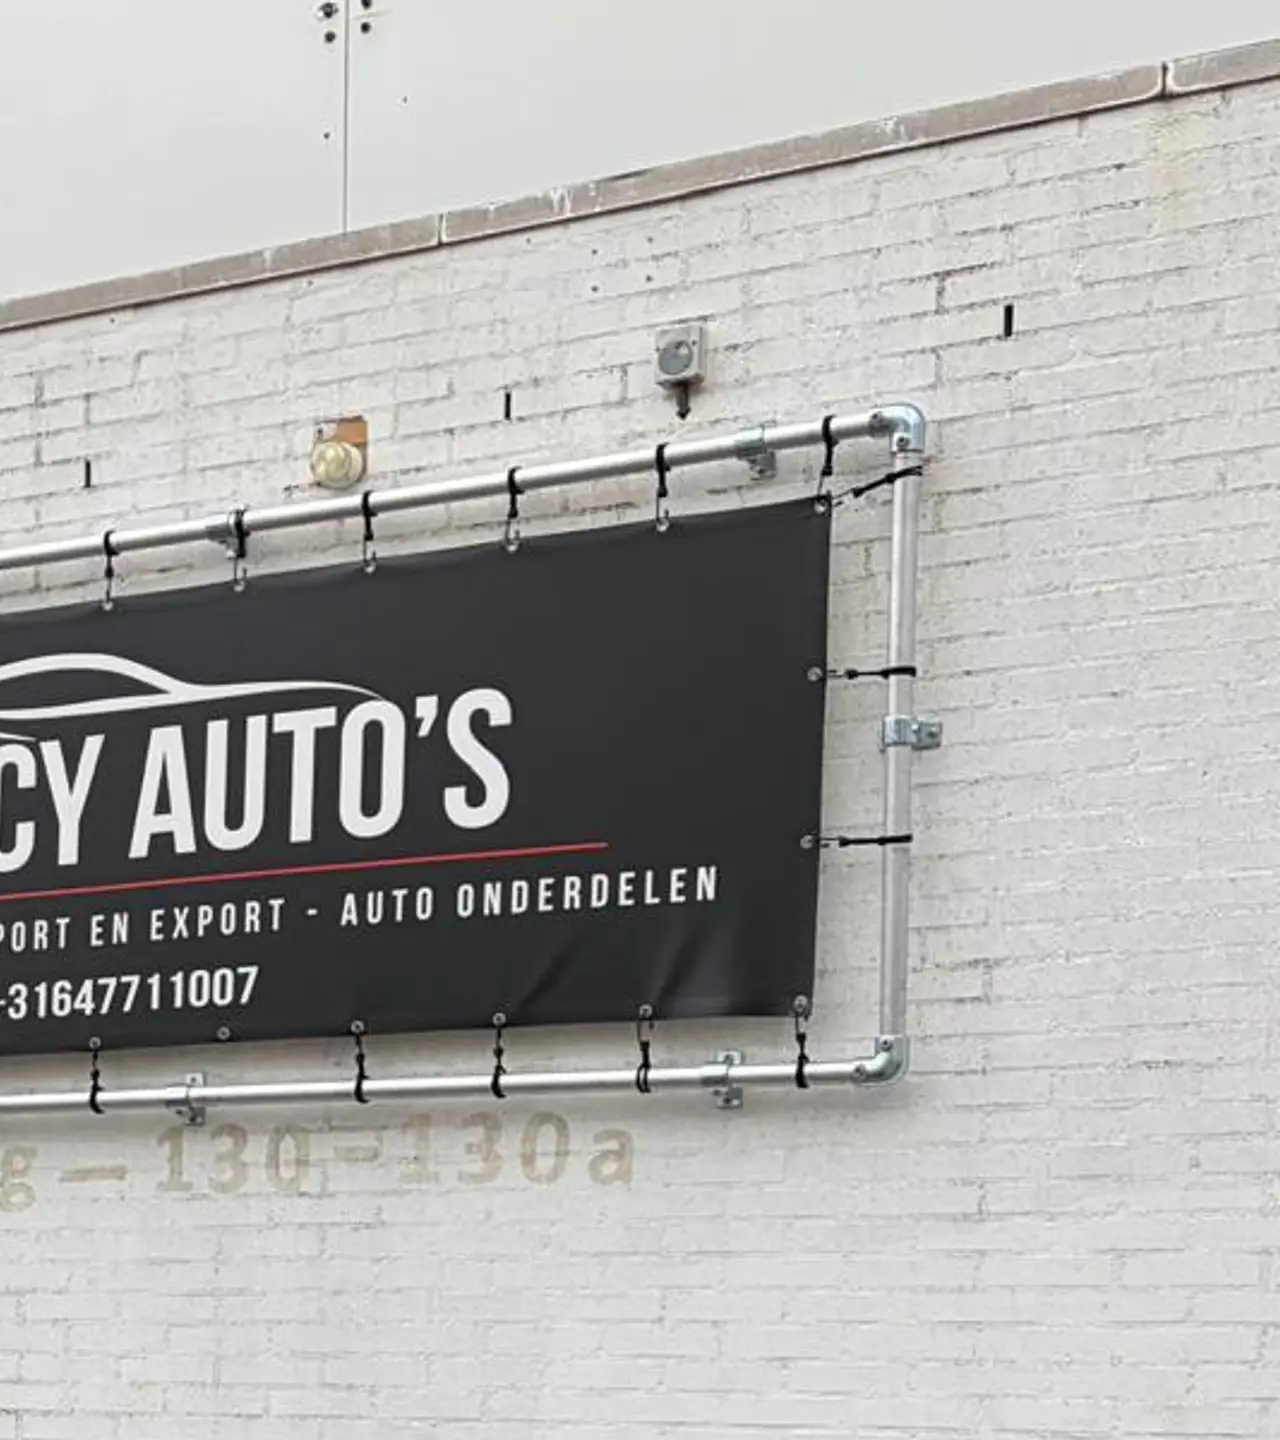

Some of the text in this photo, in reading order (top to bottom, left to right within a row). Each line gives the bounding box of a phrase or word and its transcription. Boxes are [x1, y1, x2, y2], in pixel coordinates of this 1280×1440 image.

[128, 687, 514, 860] AUTO'S
[90, 912, 129, 947] EN
[150, 898, 286, 941] EXPORT
[340, 886, 435, 927] AUTO
[456, 864, 719, 918] ONDERDELEN
